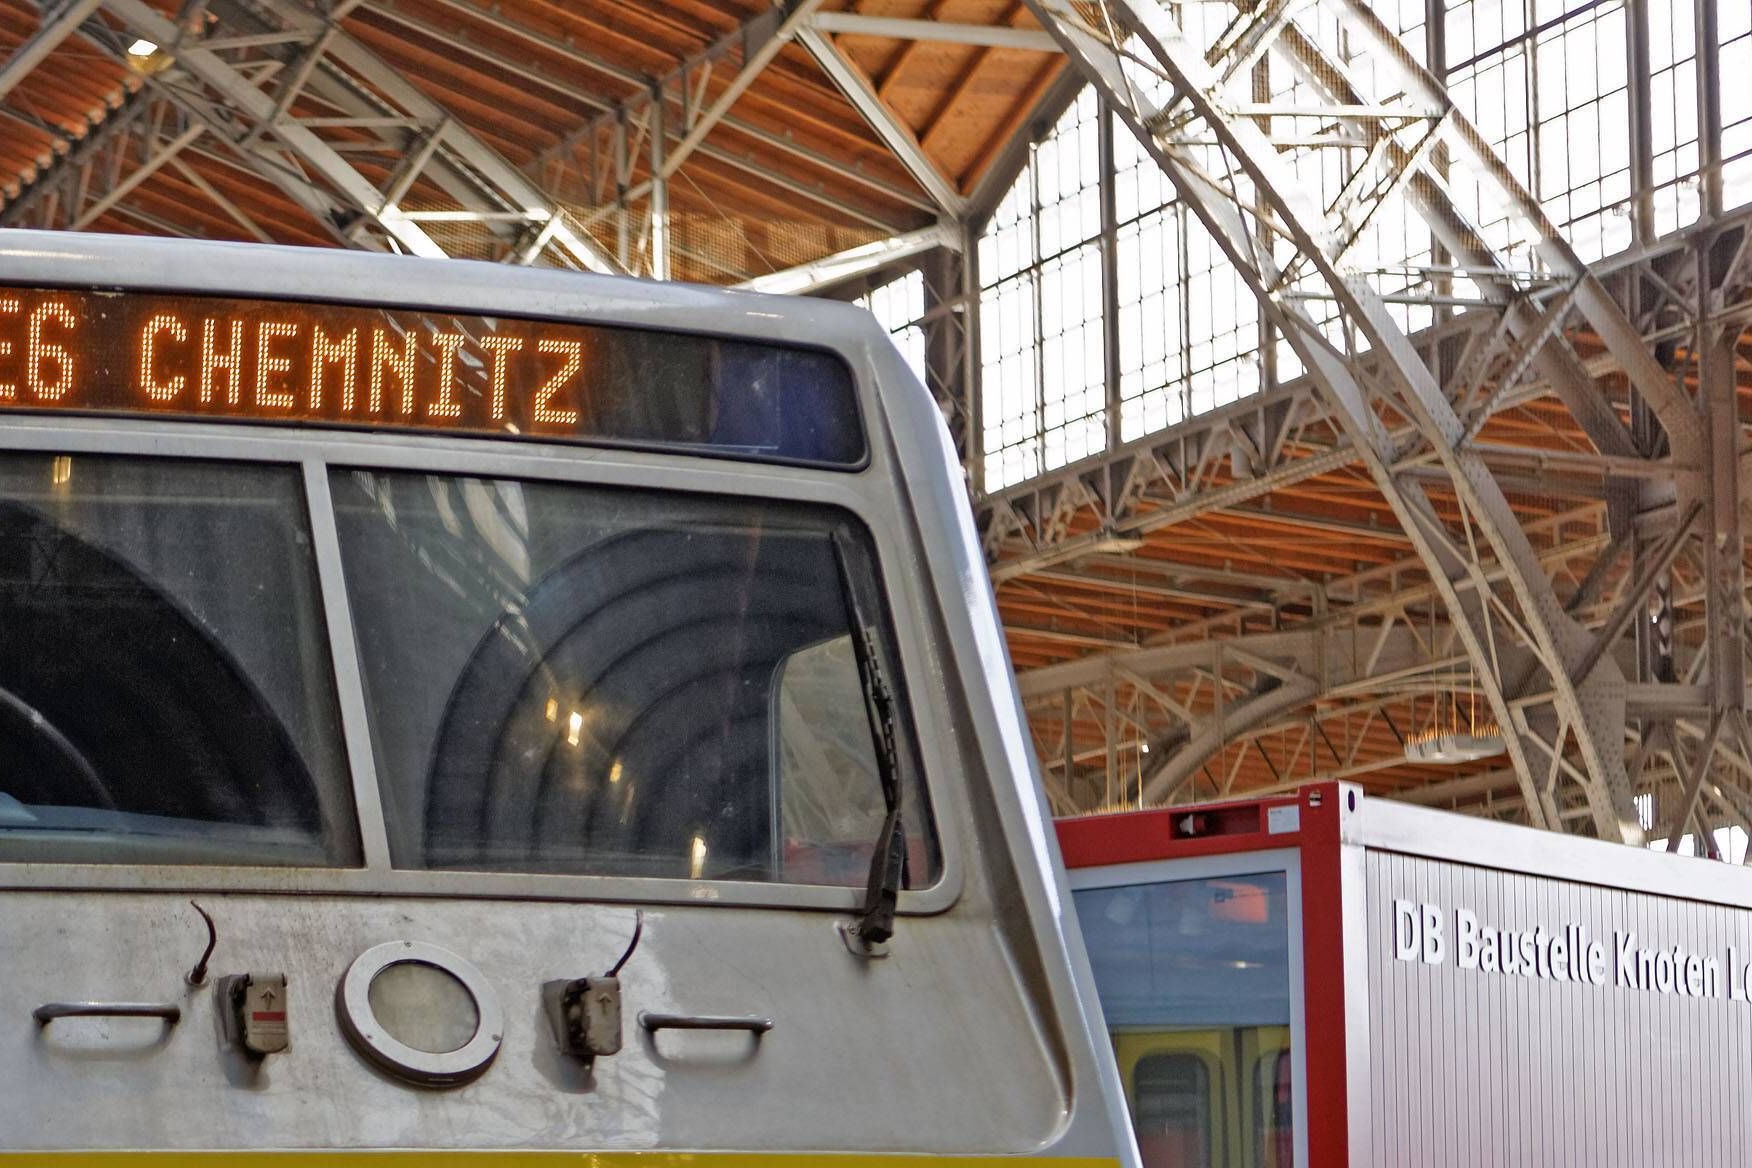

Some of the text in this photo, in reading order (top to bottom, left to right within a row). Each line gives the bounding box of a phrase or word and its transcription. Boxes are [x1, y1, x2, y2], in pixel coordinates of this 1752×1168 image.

[138, 315, 583, 424] CHEMNITZ
[1394, 899, 1445, 963] DB
[1455, 909, 1606, 985] Baustelle
[1614, 930, 1721, 998] Knoten
